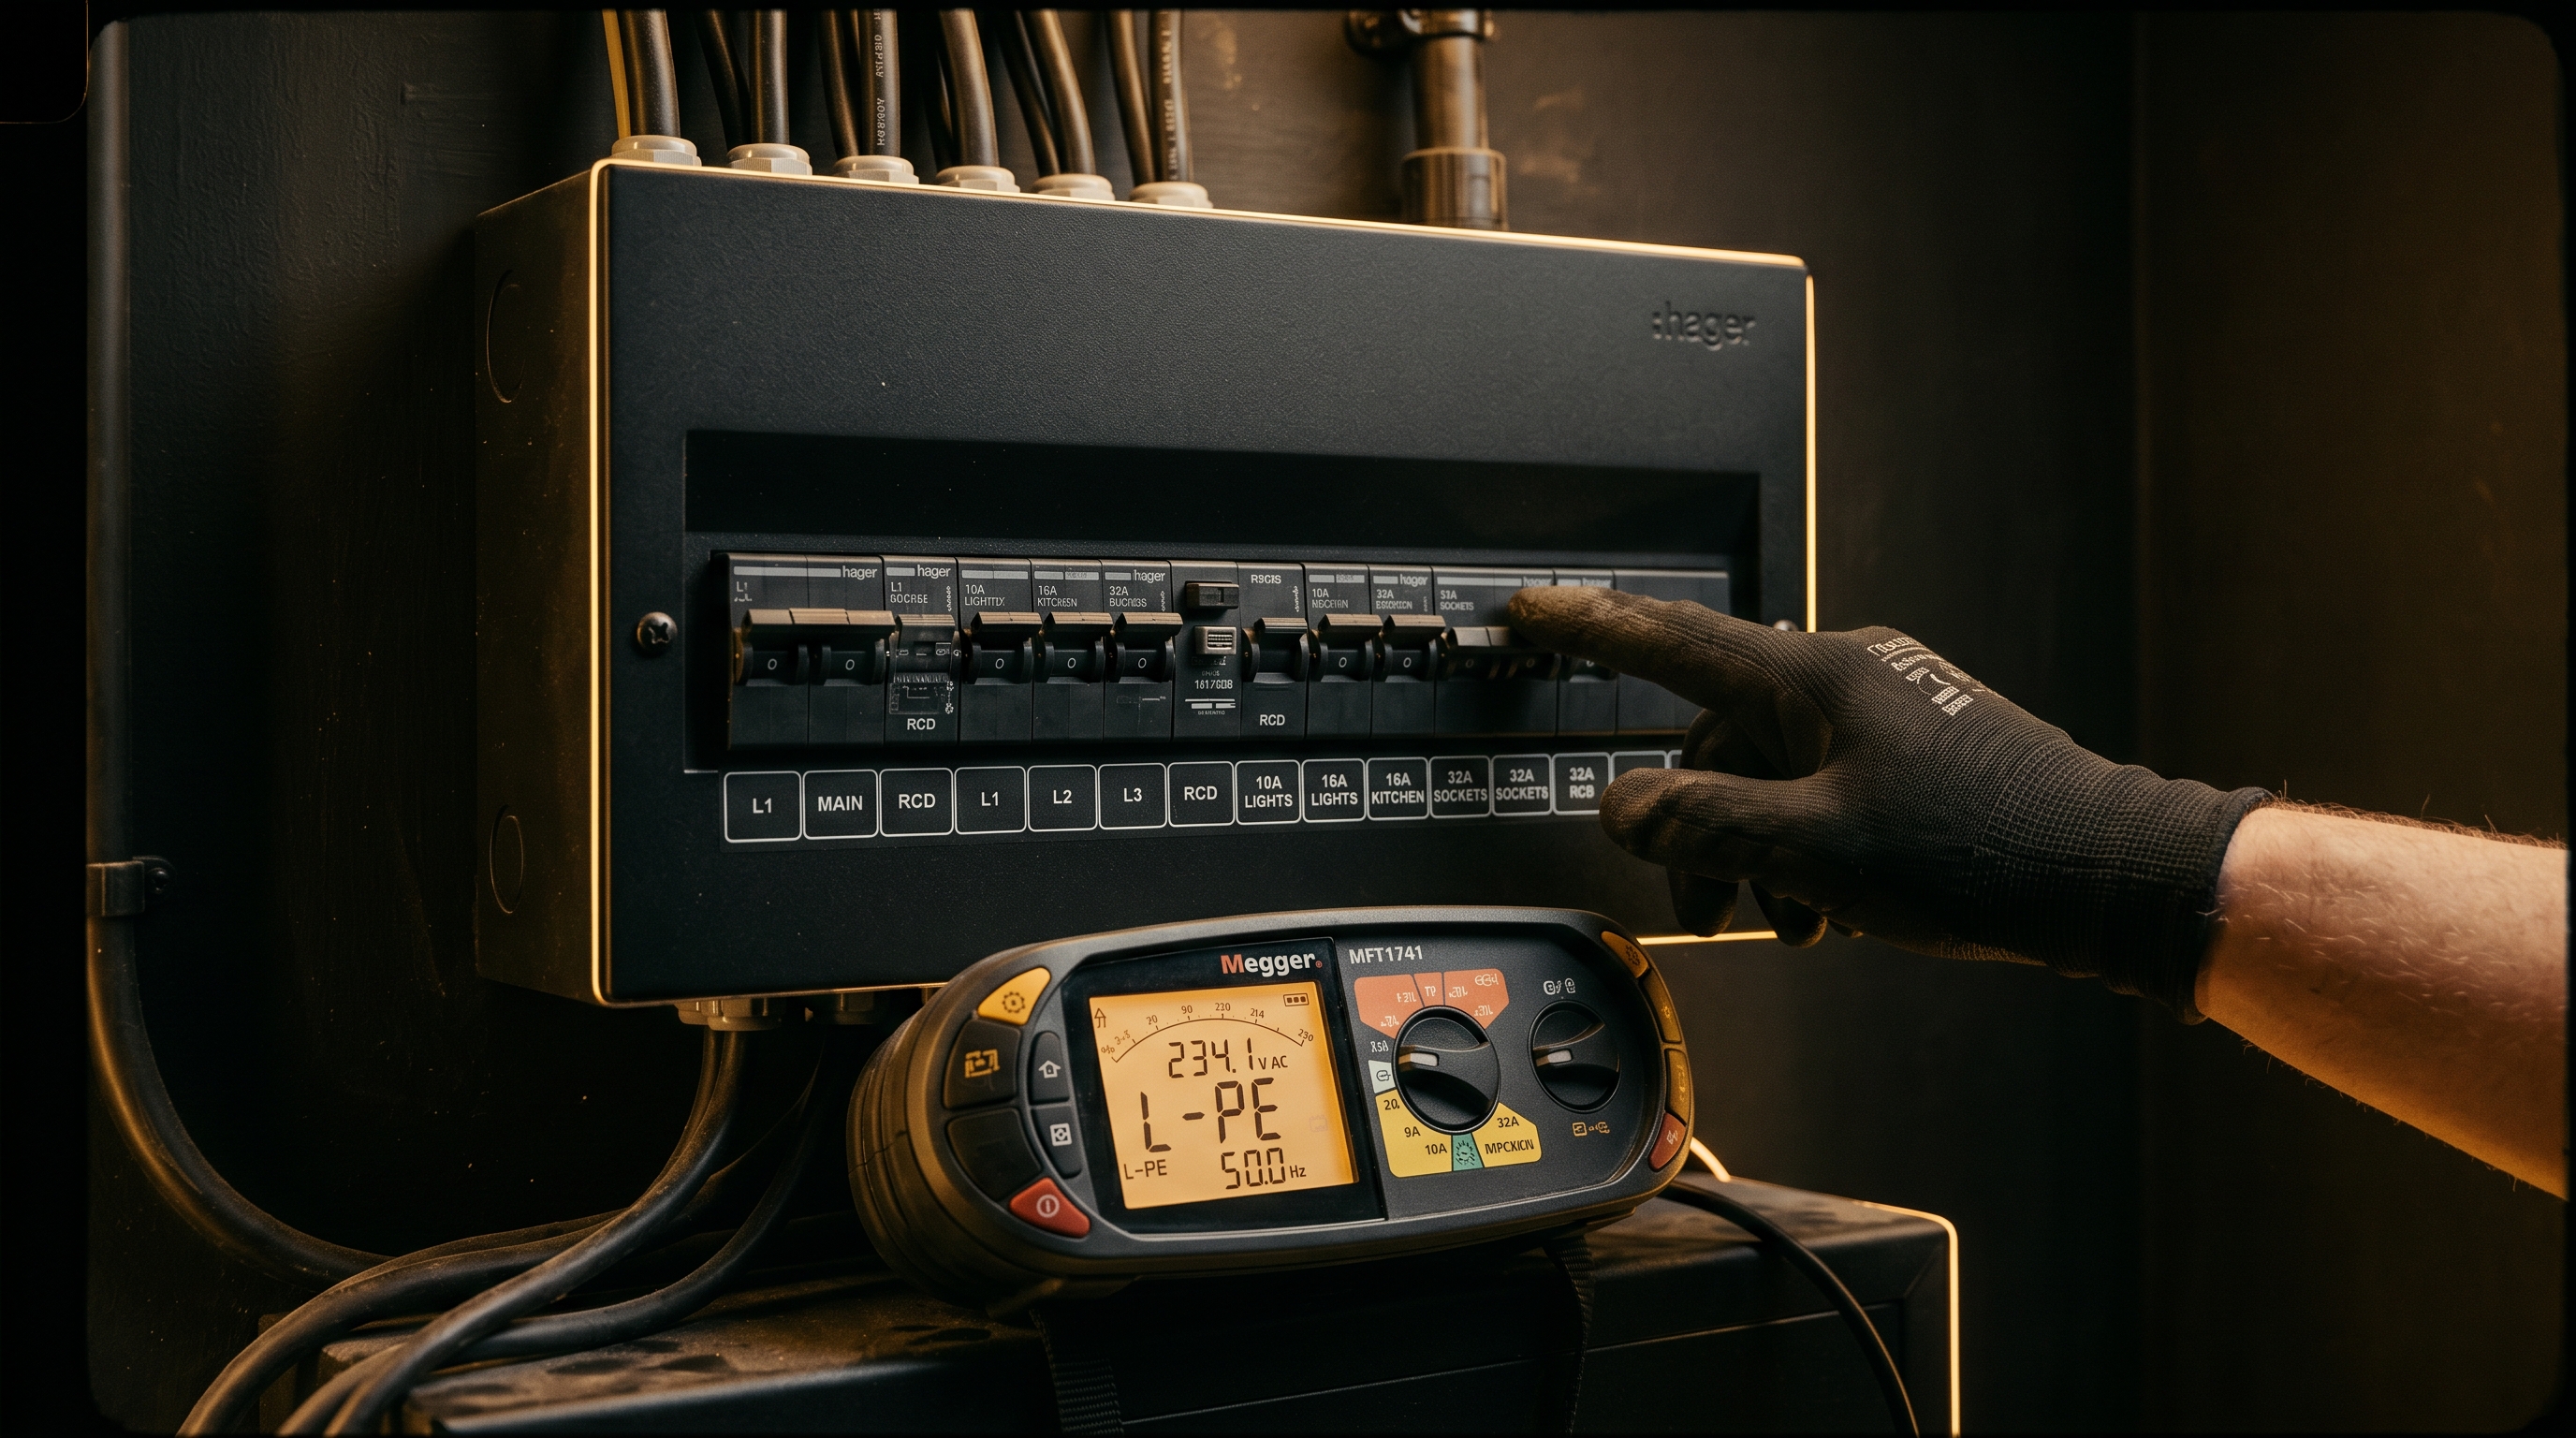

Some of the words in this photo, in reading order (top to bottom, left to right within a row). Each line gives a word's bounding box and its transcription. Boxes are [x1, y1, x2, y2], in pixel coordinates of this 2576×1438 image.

[842, 565, 878, 580] hager
[916, 564, 951, 580] hager
[1134, 569, 1165, 583] hager
[964, 584, 986, 595] 10A
[1038, 585, 1058, 596] 16A
[1109, 586, 1129, 596] 32A
[1311, 588, 1330, 598] 10A
[1376, 589, 1395, 599] 32A
[906, 717, 936, 730] RCD
[1259, 714, 1286, 726] RCD
[1322, 773, 1348, 787] 16A
[1385, 772, 1412, 786] 16A
[1447, 770, 1473, 785] 32A
[1509, 769, 1535, 783] 32A
[1569, 767, 1595, 781] 32A
[1256, 775, 1282, 789] 10A
[981, 791, 999, 806] L1
[1053, 789, 1073, 804] L2
[1123, 787, 1143, 802] L3
[1183, 785, 1218, 800] RCD
[1311, 792, 1358, 806] LIGHTS
[1371, 789, 1425, 804] KITCHEN
[1433, 788, 1487, 802] SOCKETS
[1495, 785, 1548, 800] SOCKETS
[752, 798, 772, 814] L1
[817, 796, 863, 812] MAIN
[898, 793, 936, 809] RCD
[1245, 794, 1294, 808] LIGHTS
[1349, 945, 1423, 964] MFT1741
[1168, 1036, 1254, 1078] 234.1
[1258, 1057, 1267, 1070] V
[1270, 1054, 1289, 1069] AC
[1139, 1077, 1282, 1153] L-PE
[1497, 1115, 1520, 1128] 32A
[1404, 1126, 1421, 1138] 9A
[1425, 1143, 1448, 1155] 10A
[1123, 1158, 1168, 1181] L-PE
[1221, 1146, 1286, 1190] 50.0
[1289, 1165, 1307, 1179] Hz
